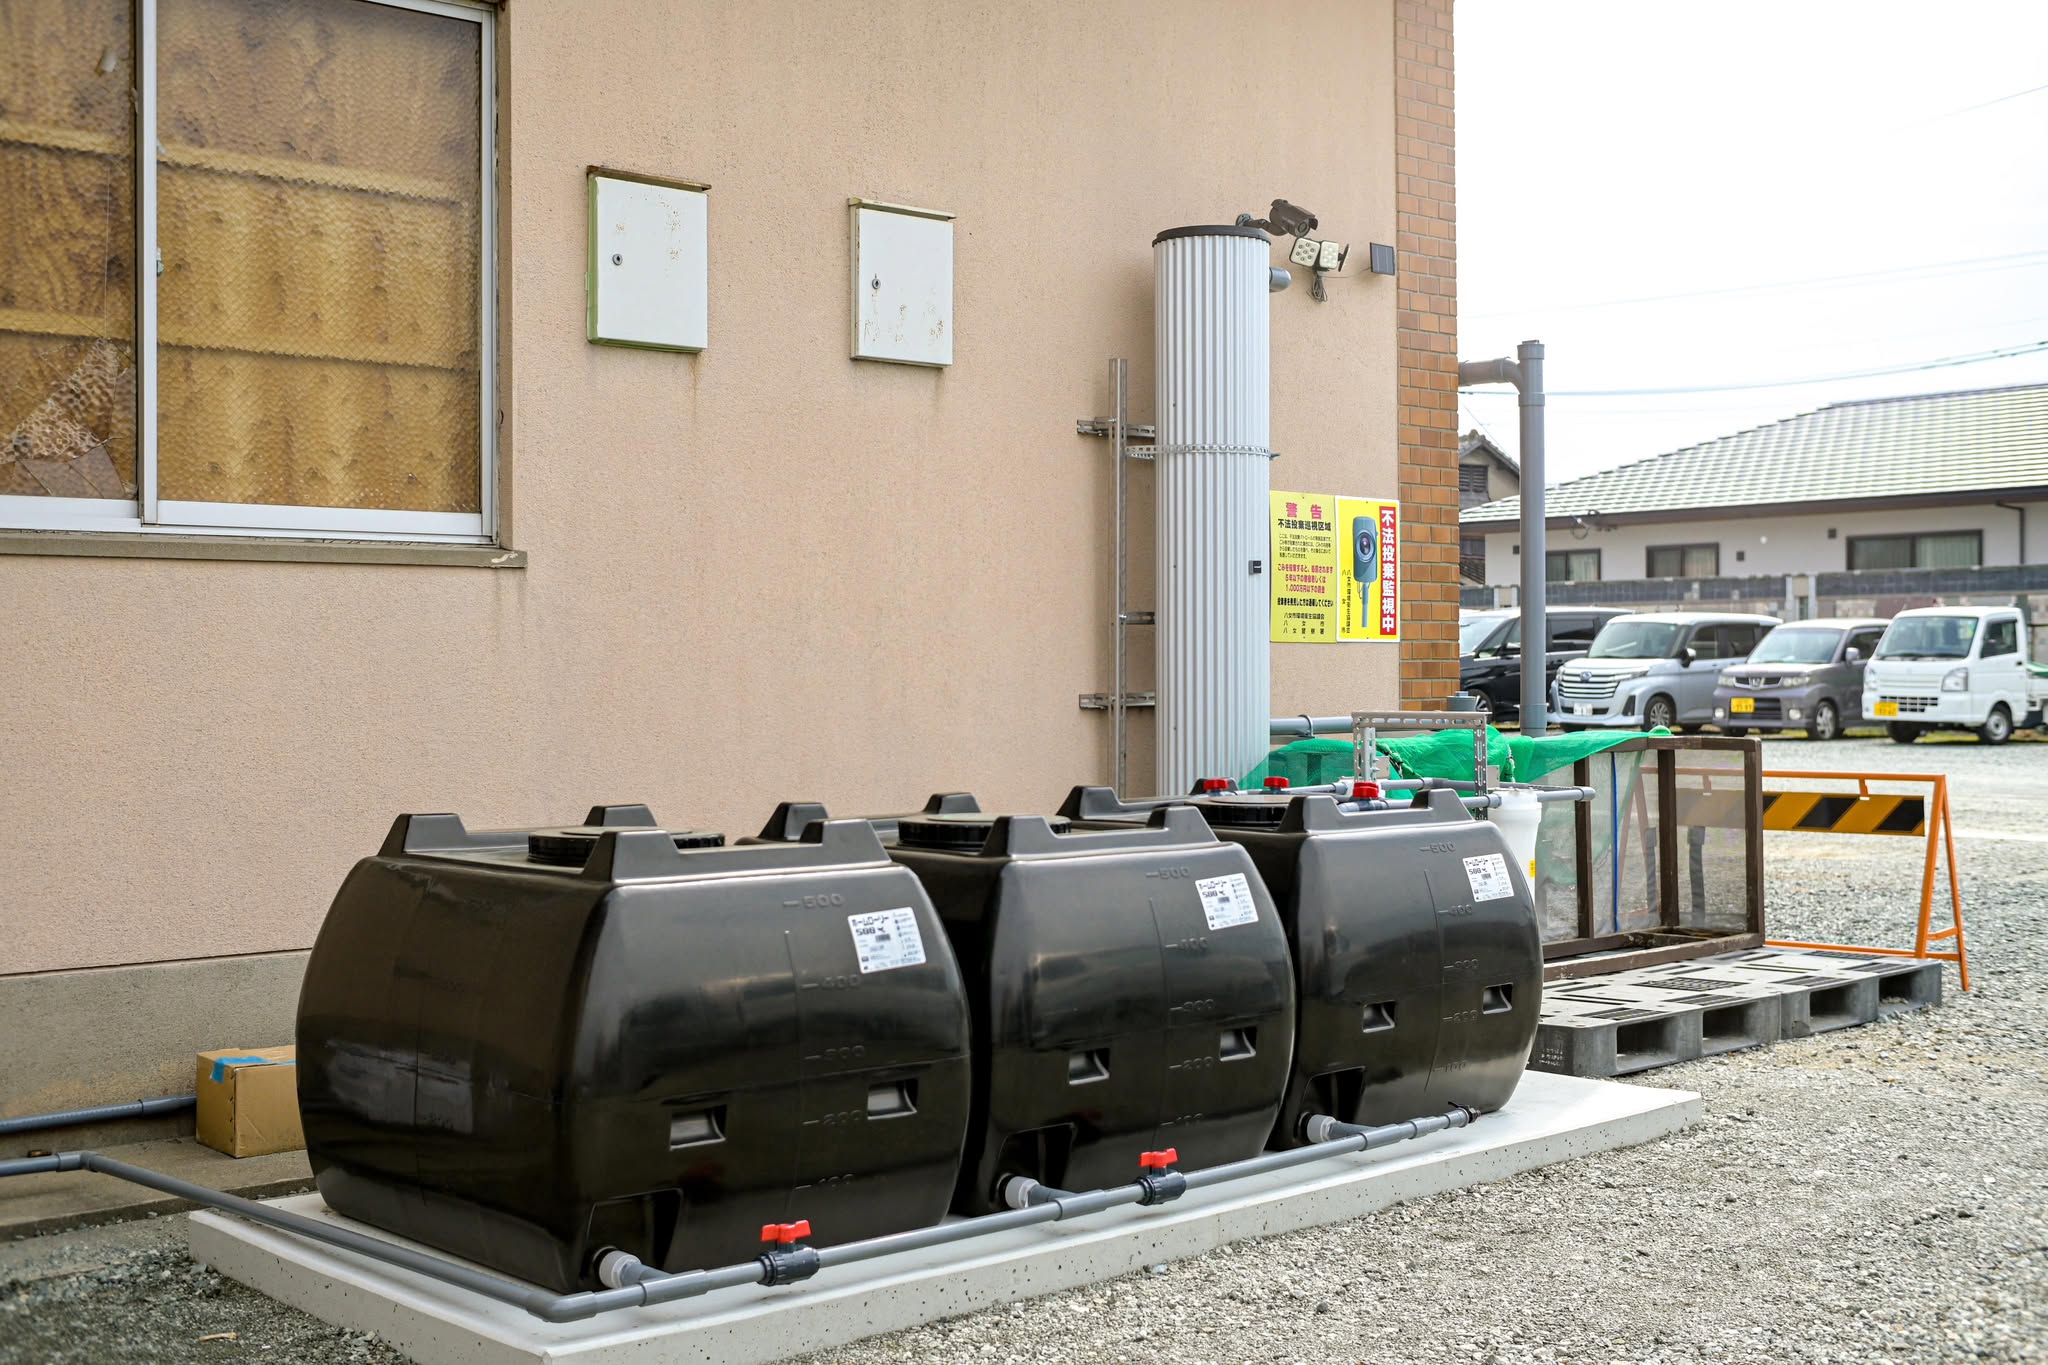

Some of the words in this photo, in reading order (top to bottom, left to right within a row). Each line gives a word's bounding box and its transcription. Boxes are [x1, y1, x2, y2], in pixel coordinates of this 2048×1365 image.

[1286, 502, 1322, 520] 警告
[1381, 509, 1395, 633] 不法投棄監視中
[1430, 840, 1457, 853] 500
[1159, 866, 1191, 880] 500
[802, 892, 846, 909] 500
[855, 926, 876, 936] 500
